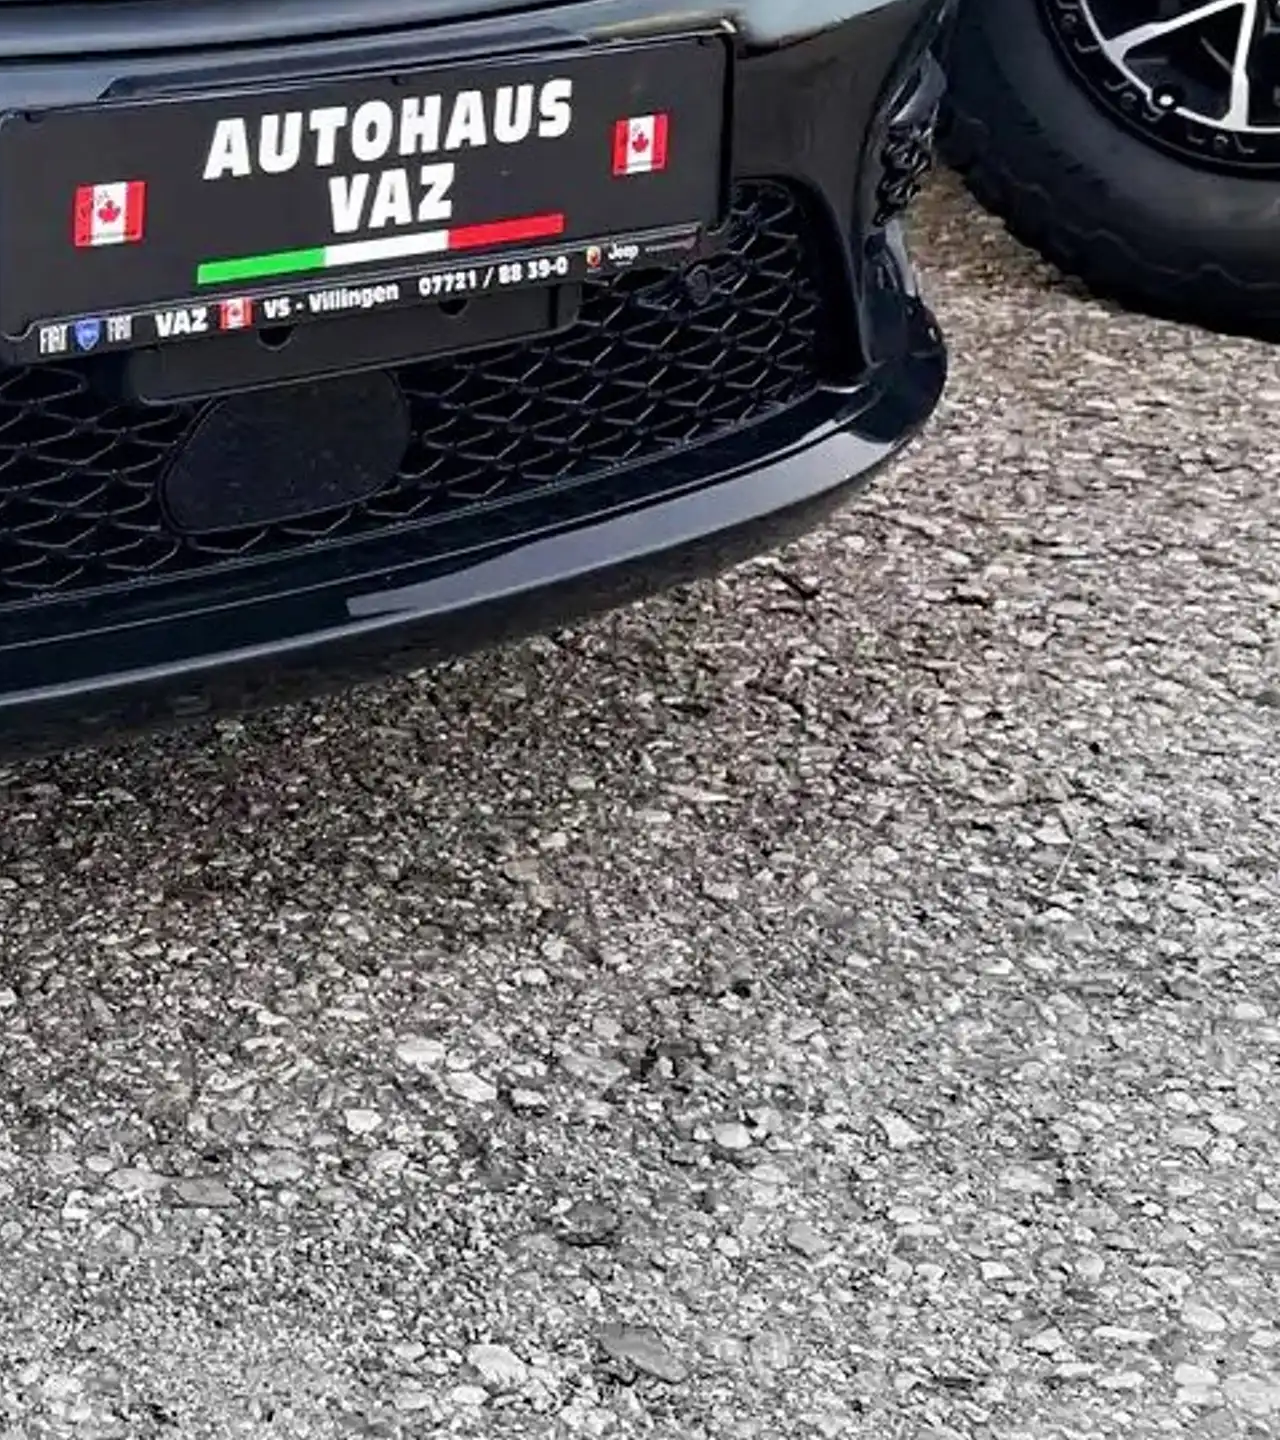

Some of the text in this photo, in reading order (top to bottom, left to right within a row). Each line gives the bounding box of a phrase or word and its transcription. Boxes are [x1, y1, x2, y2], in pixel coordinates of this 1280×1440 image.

[202, 78, 573, 180] AUTOHAUS
[329, 162, 455, 234] VAZ
[154, 308, 208, 338] VAZ
[263, 298, 291, 319] VS
[308, 282, 400, 313] Villingen
[418, 271, 477, 296] 07721
[528, 256, 568, 279] 39-0
[608, 243, 639, 261] Jeep
